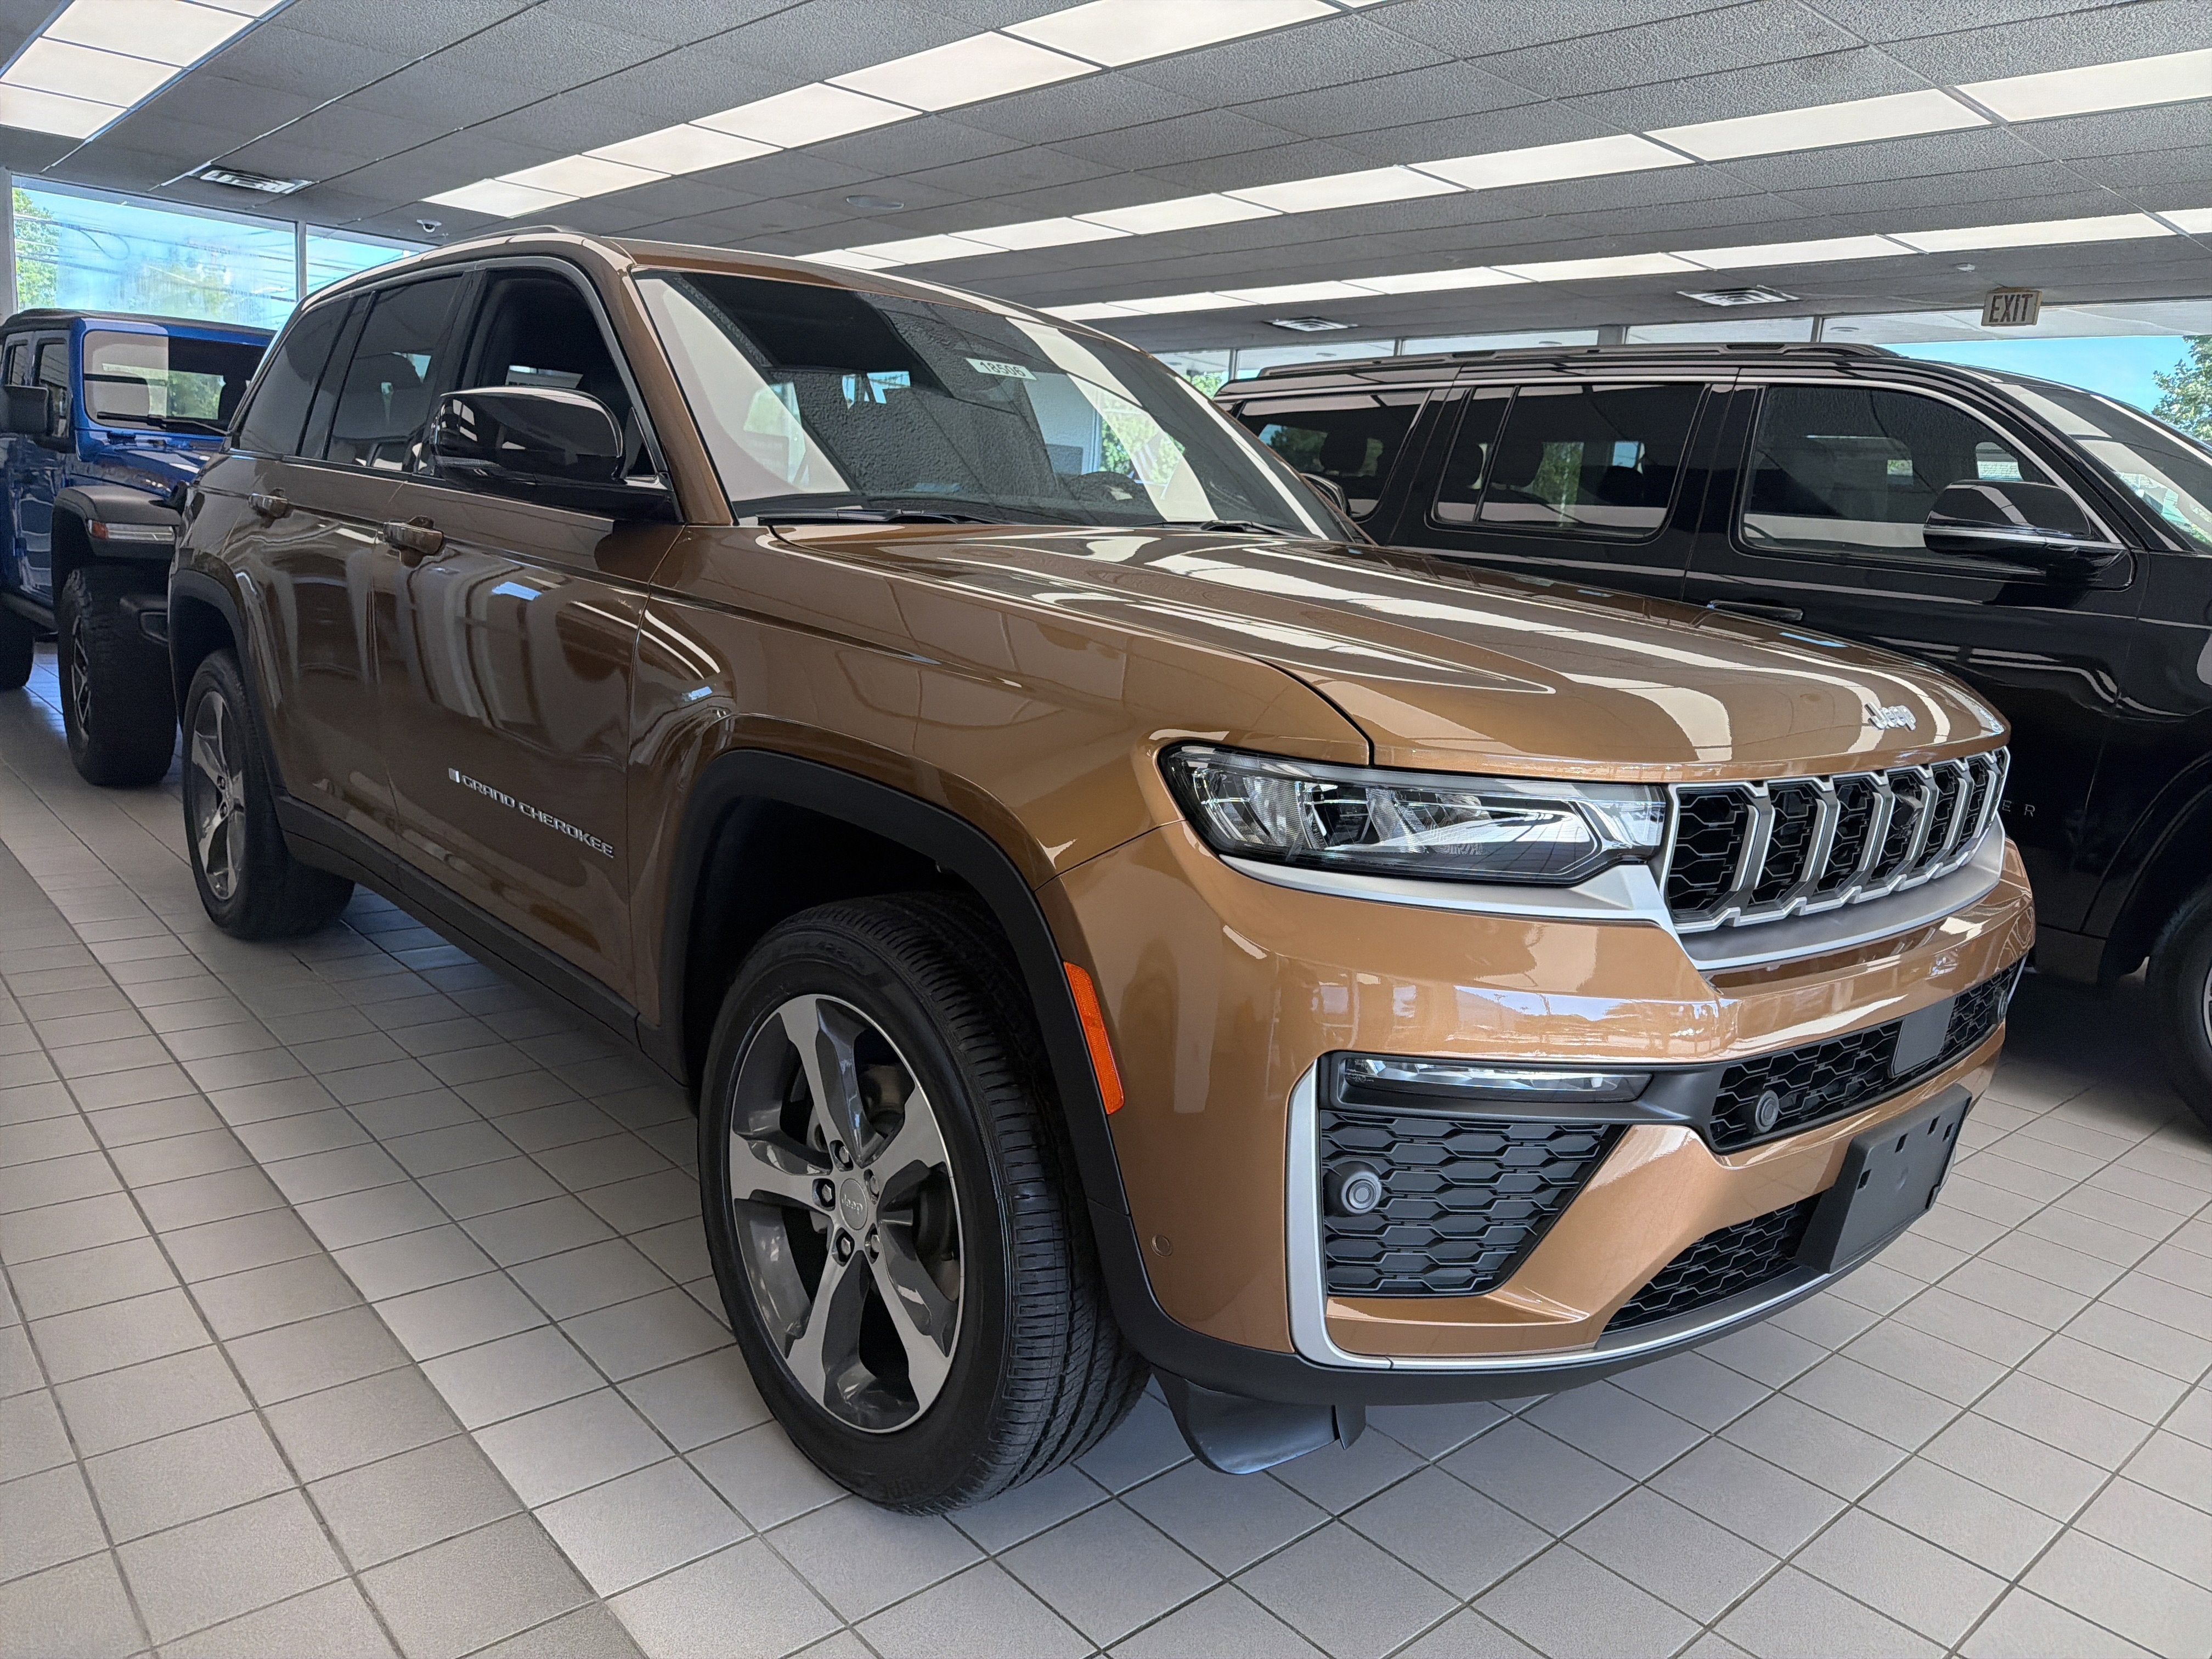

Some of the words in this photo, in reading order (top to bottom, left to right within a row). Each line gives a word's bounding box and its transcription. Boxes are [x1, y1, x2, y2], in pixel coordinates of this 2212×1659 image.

[1989, 294, 2033, 322] EXIT
[980, 362, 1026, 377] 18506
[462, 775, 515, 808] GRAND
[519, 802, 614, 859] CHEROKEE
[841, 1194, 863, 1215] Jeep
